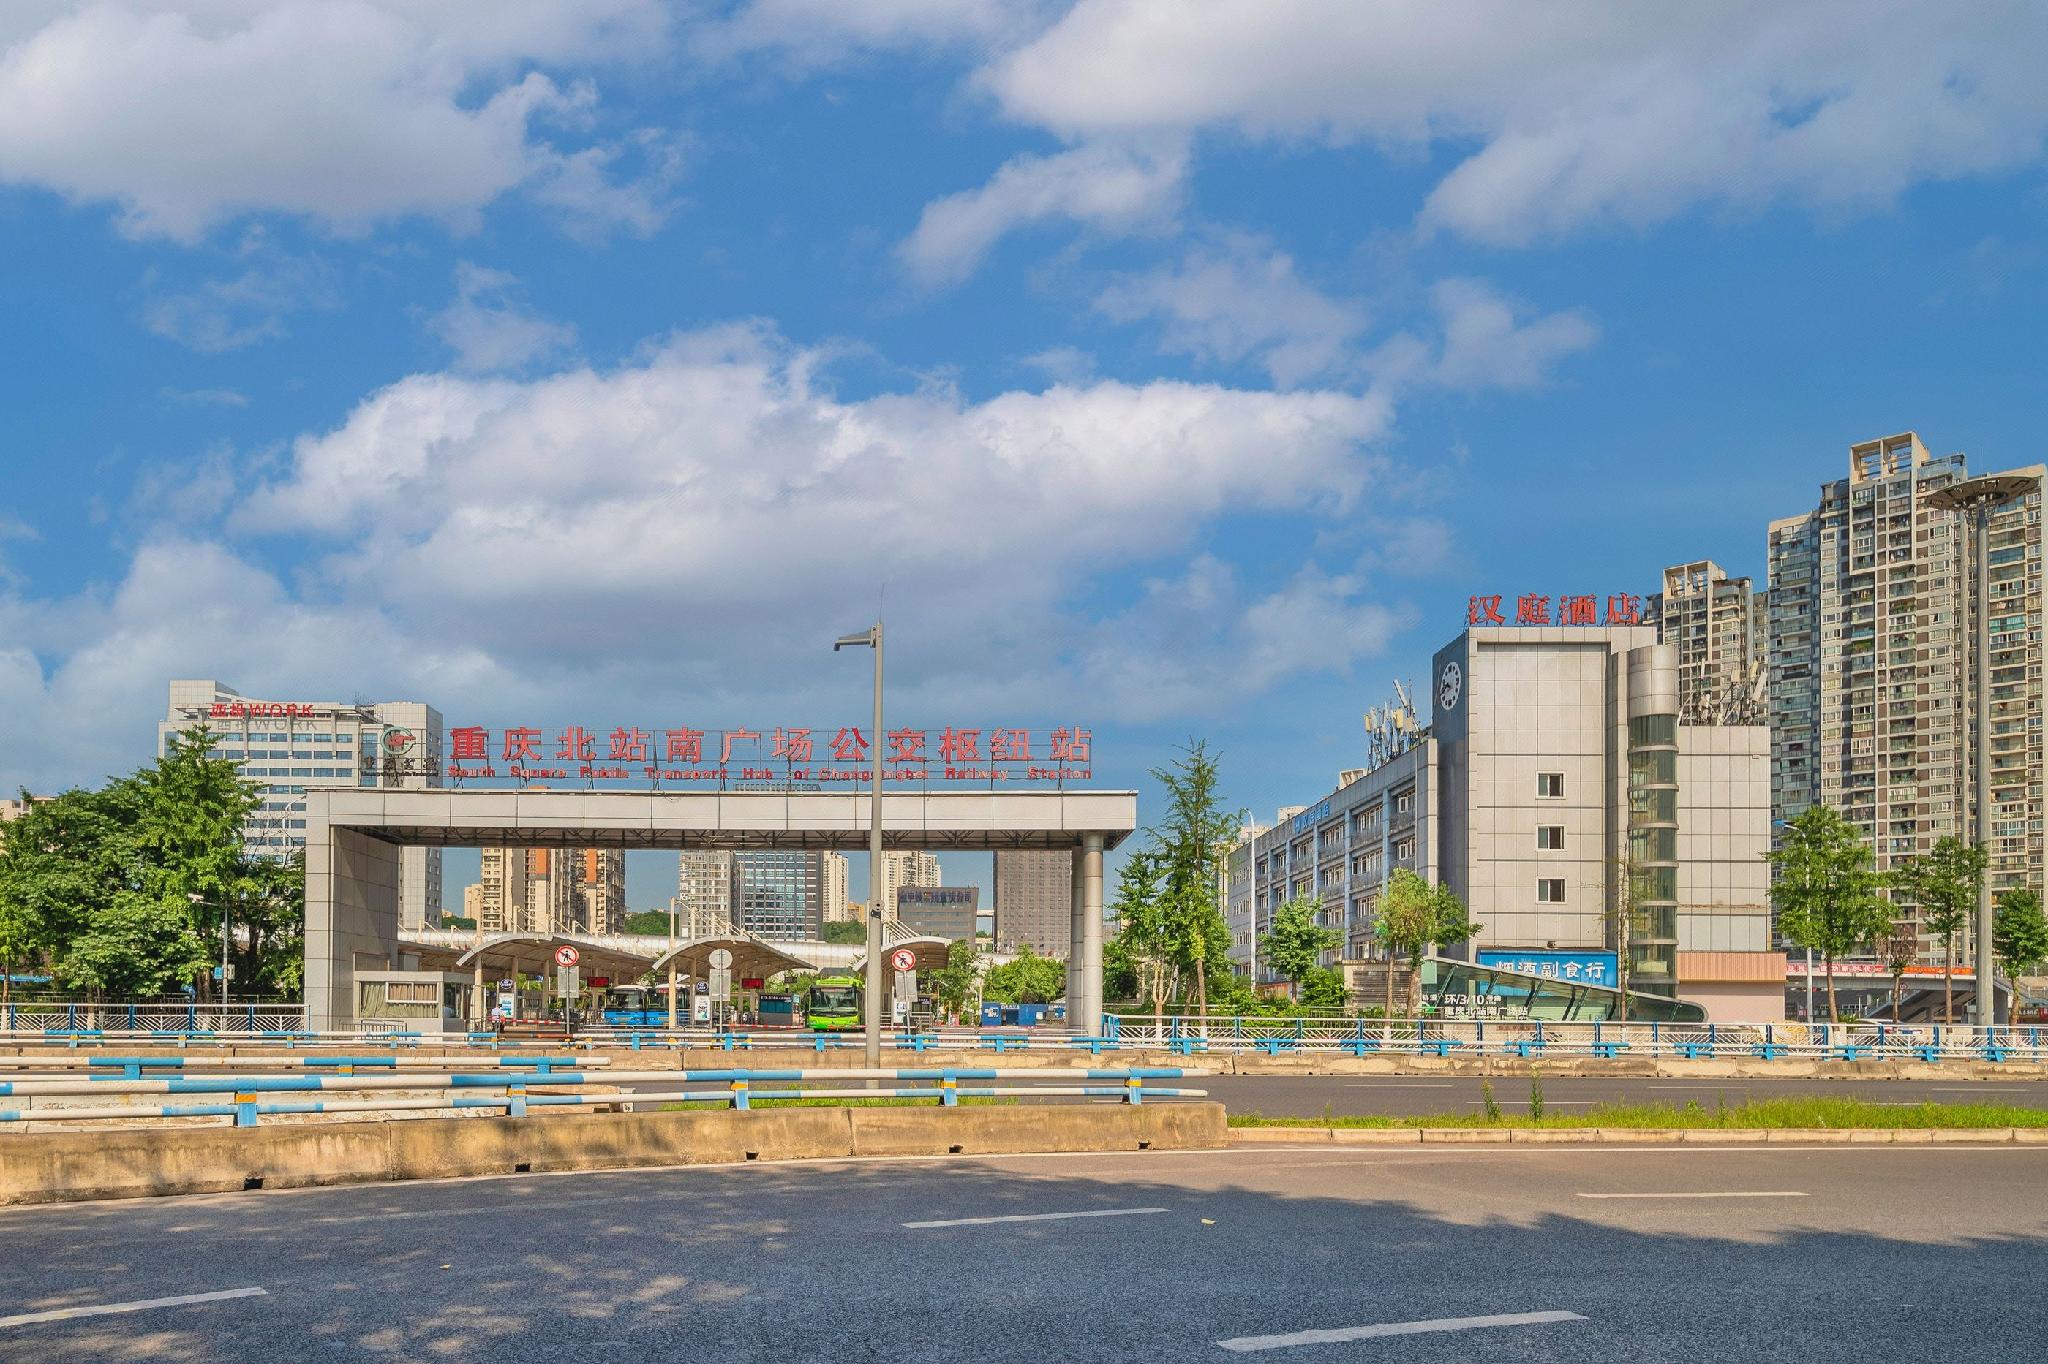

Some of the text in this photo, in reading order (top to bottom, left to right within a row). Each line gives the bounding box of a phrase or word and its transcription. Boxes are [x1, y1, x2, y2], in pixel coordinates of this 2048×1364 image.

[1467, 593, 1641, 625] 汉庭酒店
[449, 726, 1092, 764] 重庆北站南广场公交枢纽站
[448, 765, 496, 777] South
[742, 767, 773, 779] Hub
[818, 768, 929, 782] Chongingbei
[1027, 766, 1092, 779] Station
[1496, 961, 1606, 978] 烟酒副食行
